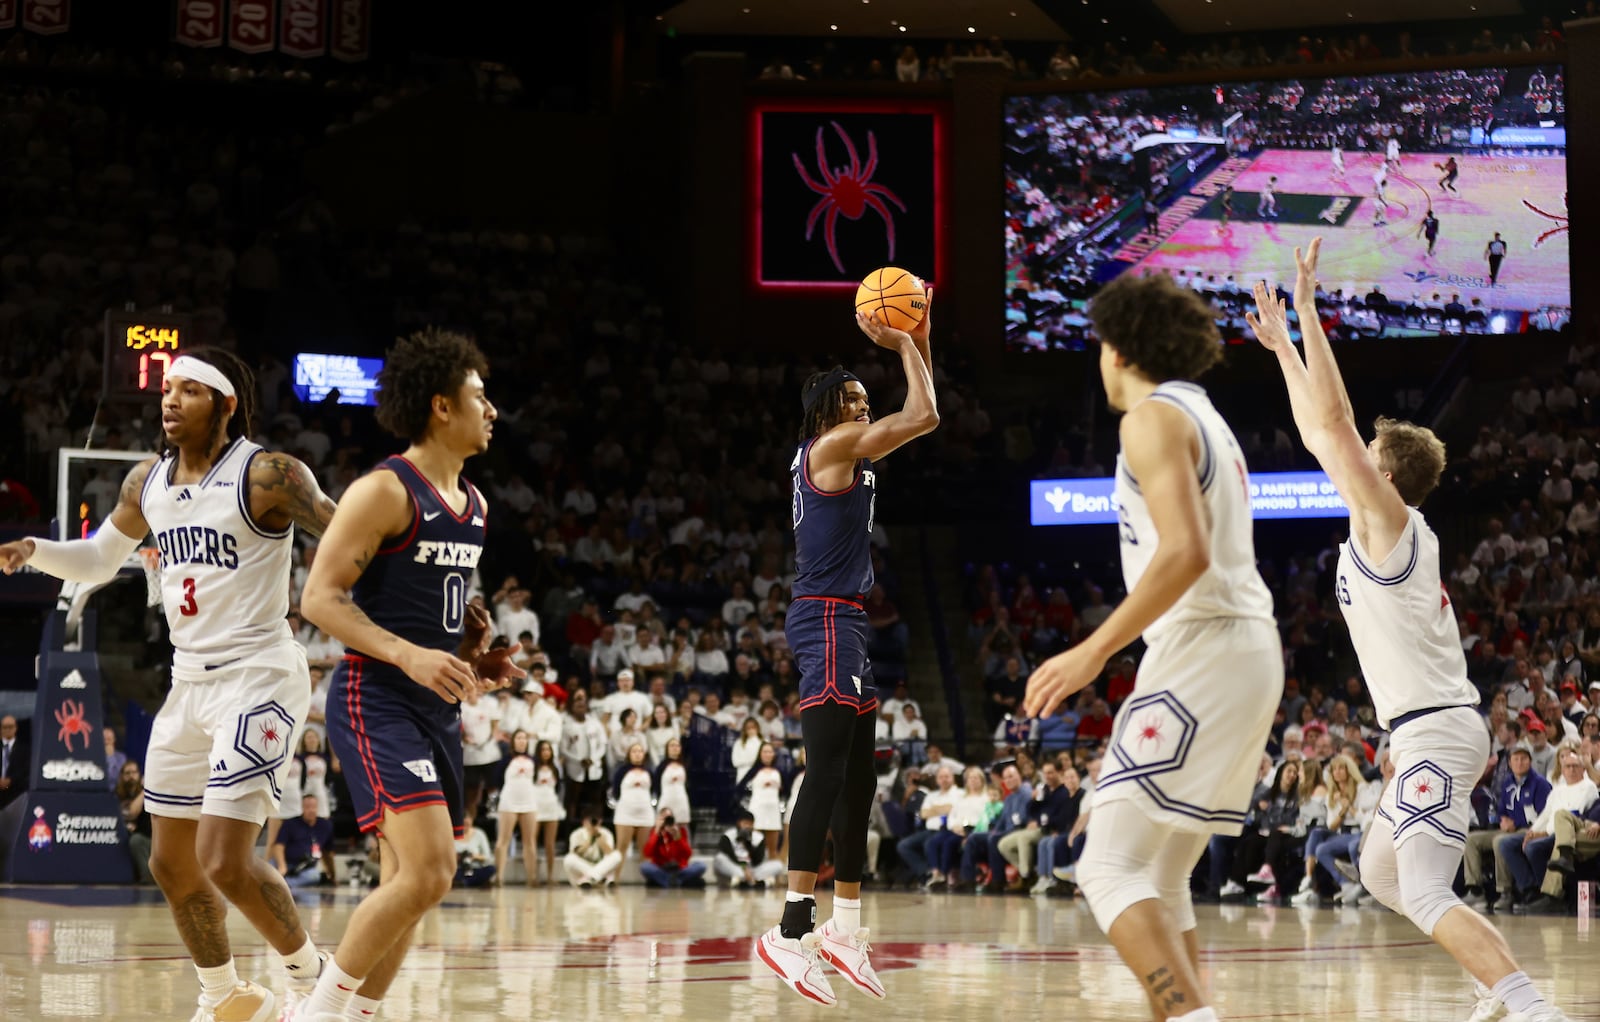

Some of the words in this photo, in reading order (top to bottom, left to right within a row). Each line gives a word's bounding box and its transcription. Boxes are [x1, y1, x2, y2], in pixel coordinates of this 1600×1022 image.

[127, 325, 179, 350] 15:44
[139, 352, 171, 392] 17
[1072, 492, 1109, 512] Bon
[1261, 482, 1318, 496] PARTNER
[158, 526, 239, 570] PIDERS
[180, 578, 198, 616] 3
[443, 572, 465, 633] 0
[57, 813, 118, 830] SHERWIN
